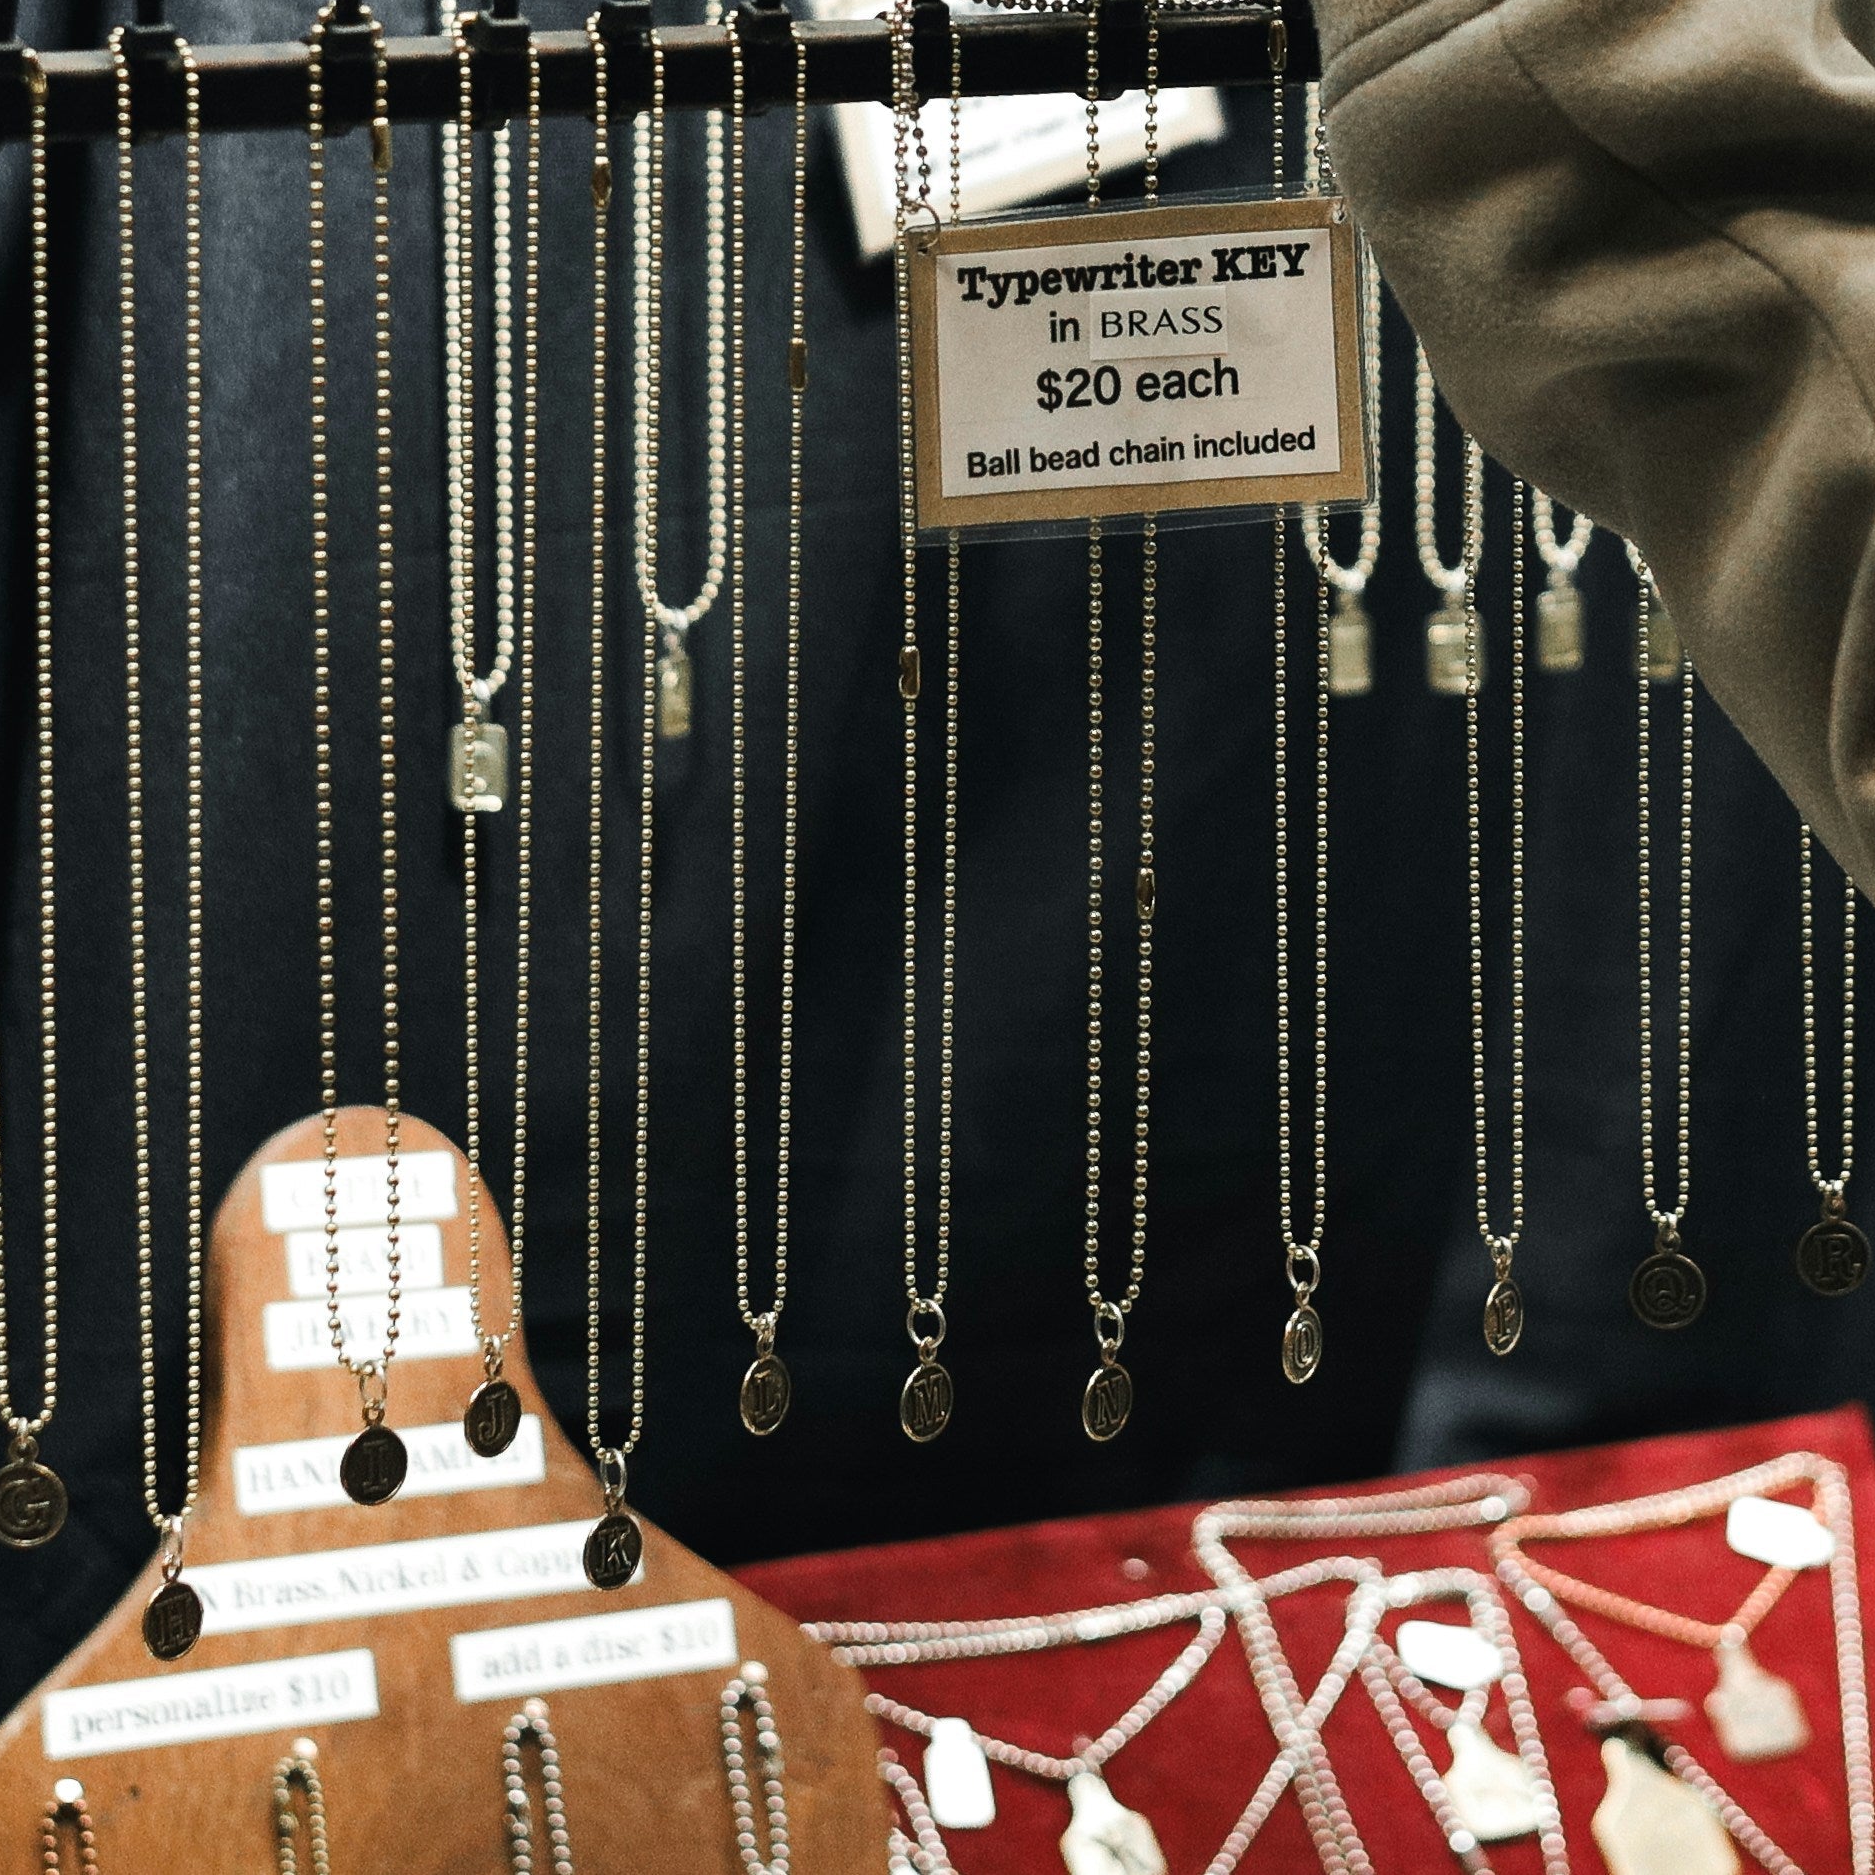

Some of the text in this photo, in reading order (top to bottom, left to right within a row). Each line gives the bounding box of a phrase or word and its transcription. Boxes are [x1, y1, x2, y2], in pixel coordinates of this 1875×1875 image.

[957, 242, 1311, 310] Typewriter KEY
[1049, 305, 1224, 344] in BRASS
[1036, 357, 1240, 414] $20 each
[966, 425, 1317, 478] Ball bead chain included
[1811, 1234, 1863, 1283] R
[1493, 1290, 1518, 1343] P
[477, 1389, 509, 1447] J
[752, 1369, 782, 1423] L
[912, 1373, 947, 1430] M
[1095, 1375, 1127, 1431] N
[247, 1454, 342, 1495] HAN
[361, 1437, 390, 1492] I
[0, 1477, 51, 1534] G
[594, 1525, 634, 1580] K
[287, 1667, 353, 1708] $10
